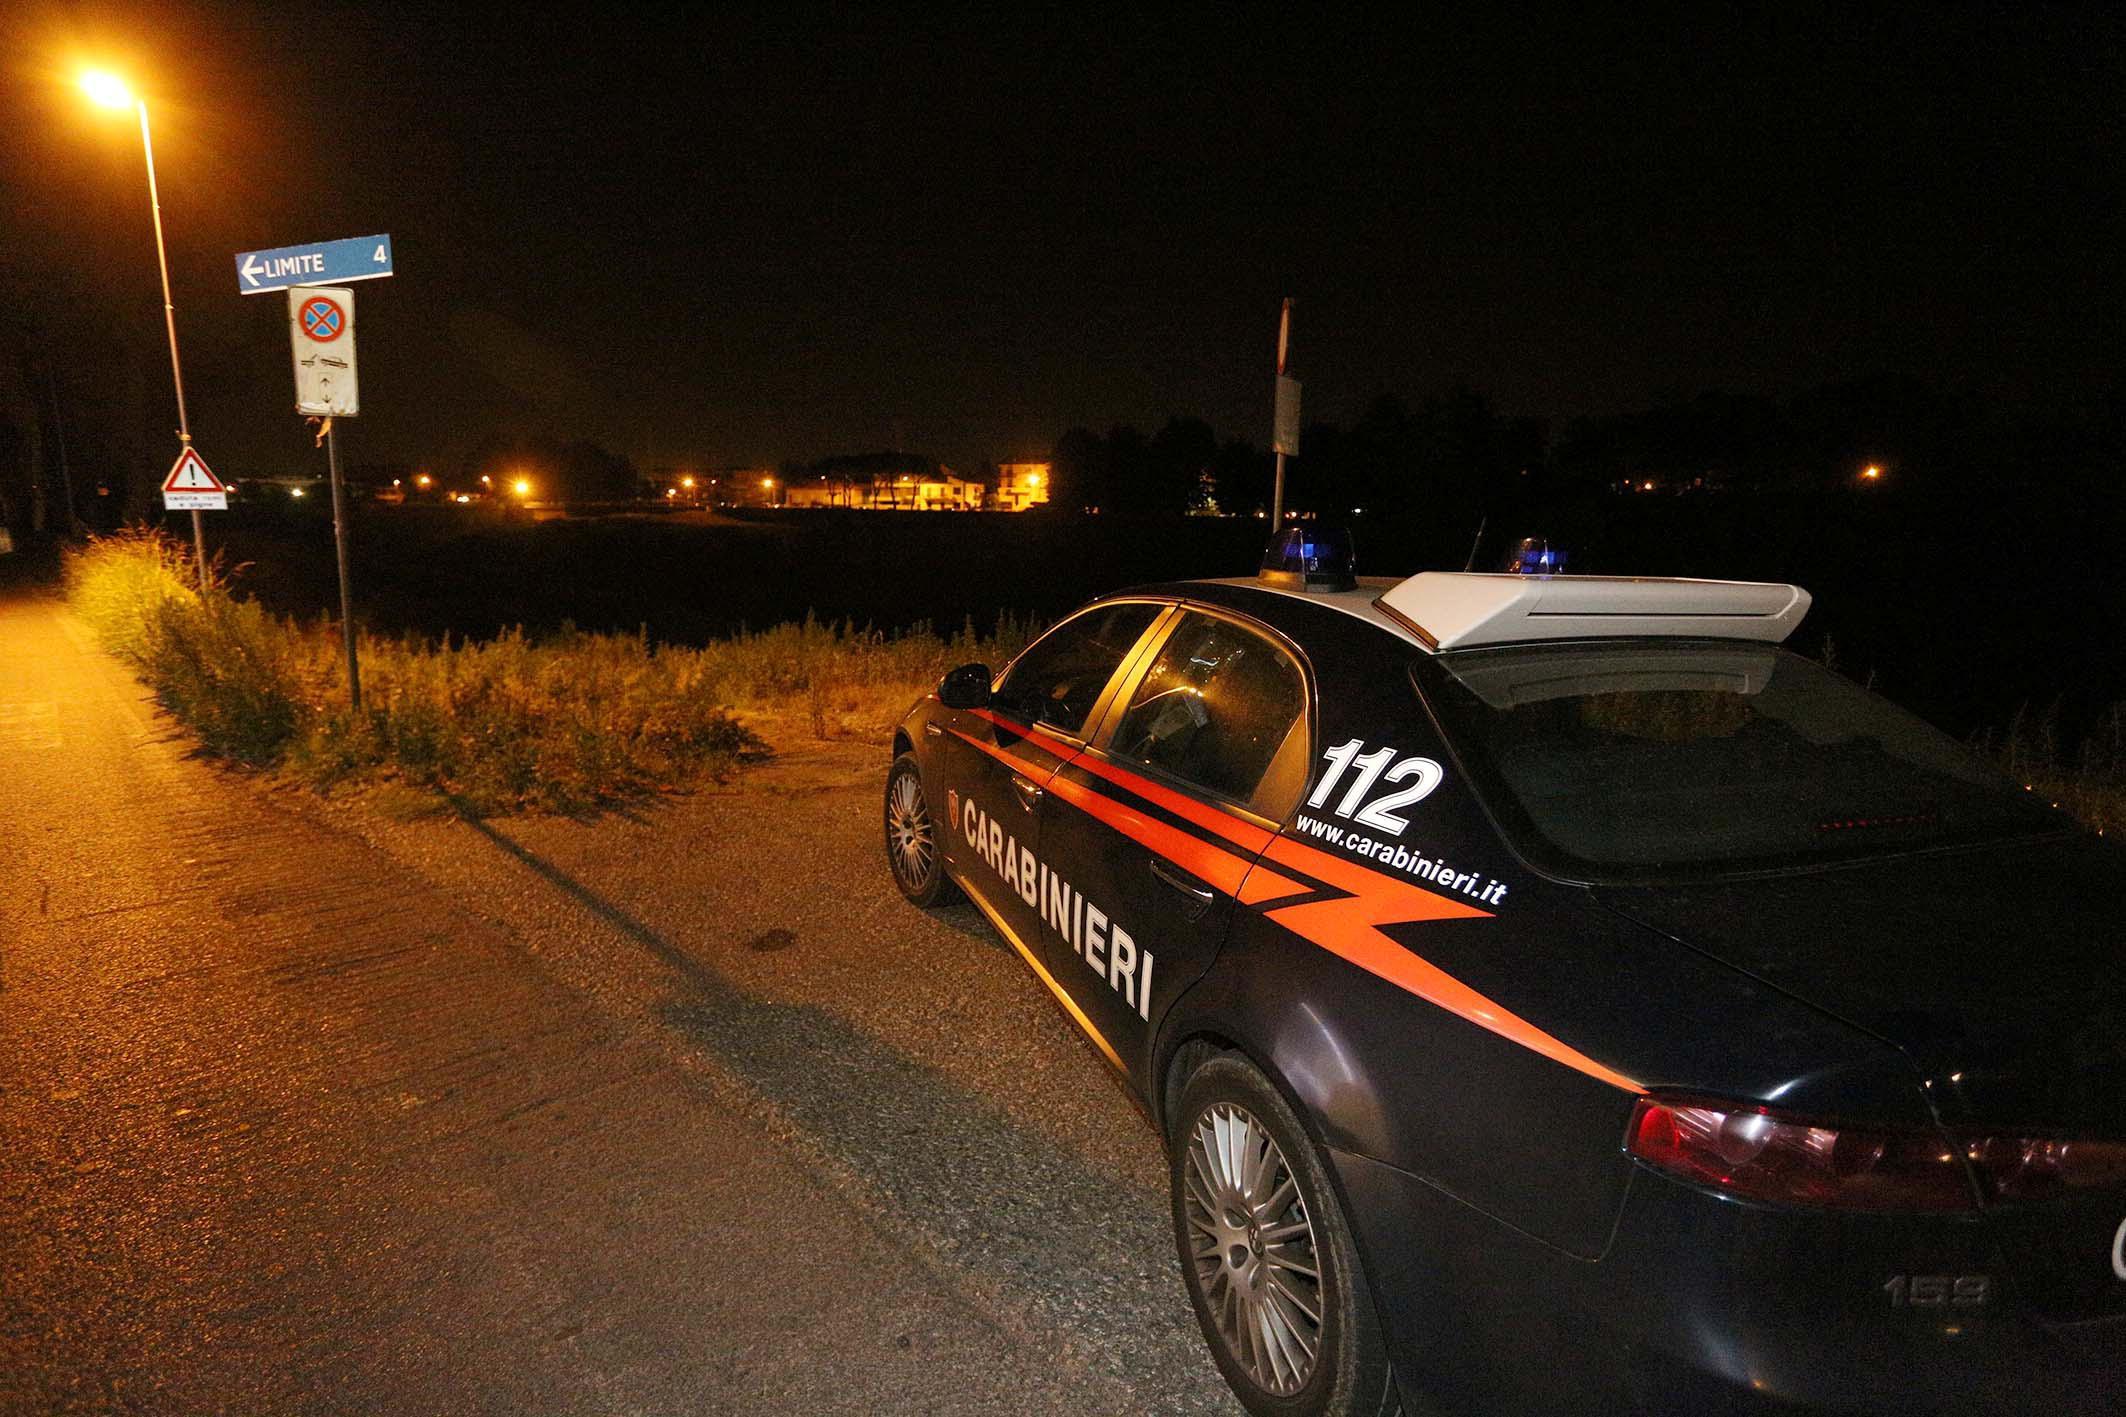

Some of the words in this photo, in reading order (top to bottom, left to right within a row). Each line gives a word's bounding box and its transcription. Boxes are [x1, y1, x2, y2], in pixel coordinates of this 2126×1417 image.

[264, 253, 325, 278] LIMITE
[373, 245, 387, 263] 4
[1307, 738, 1444, 837] 112
[1296, 814, 1508, 906] www.carabinieri.it
[964, 799, 1154, 1023] CARABINIERI
[1884, 1275, 1989, 1306] 159
